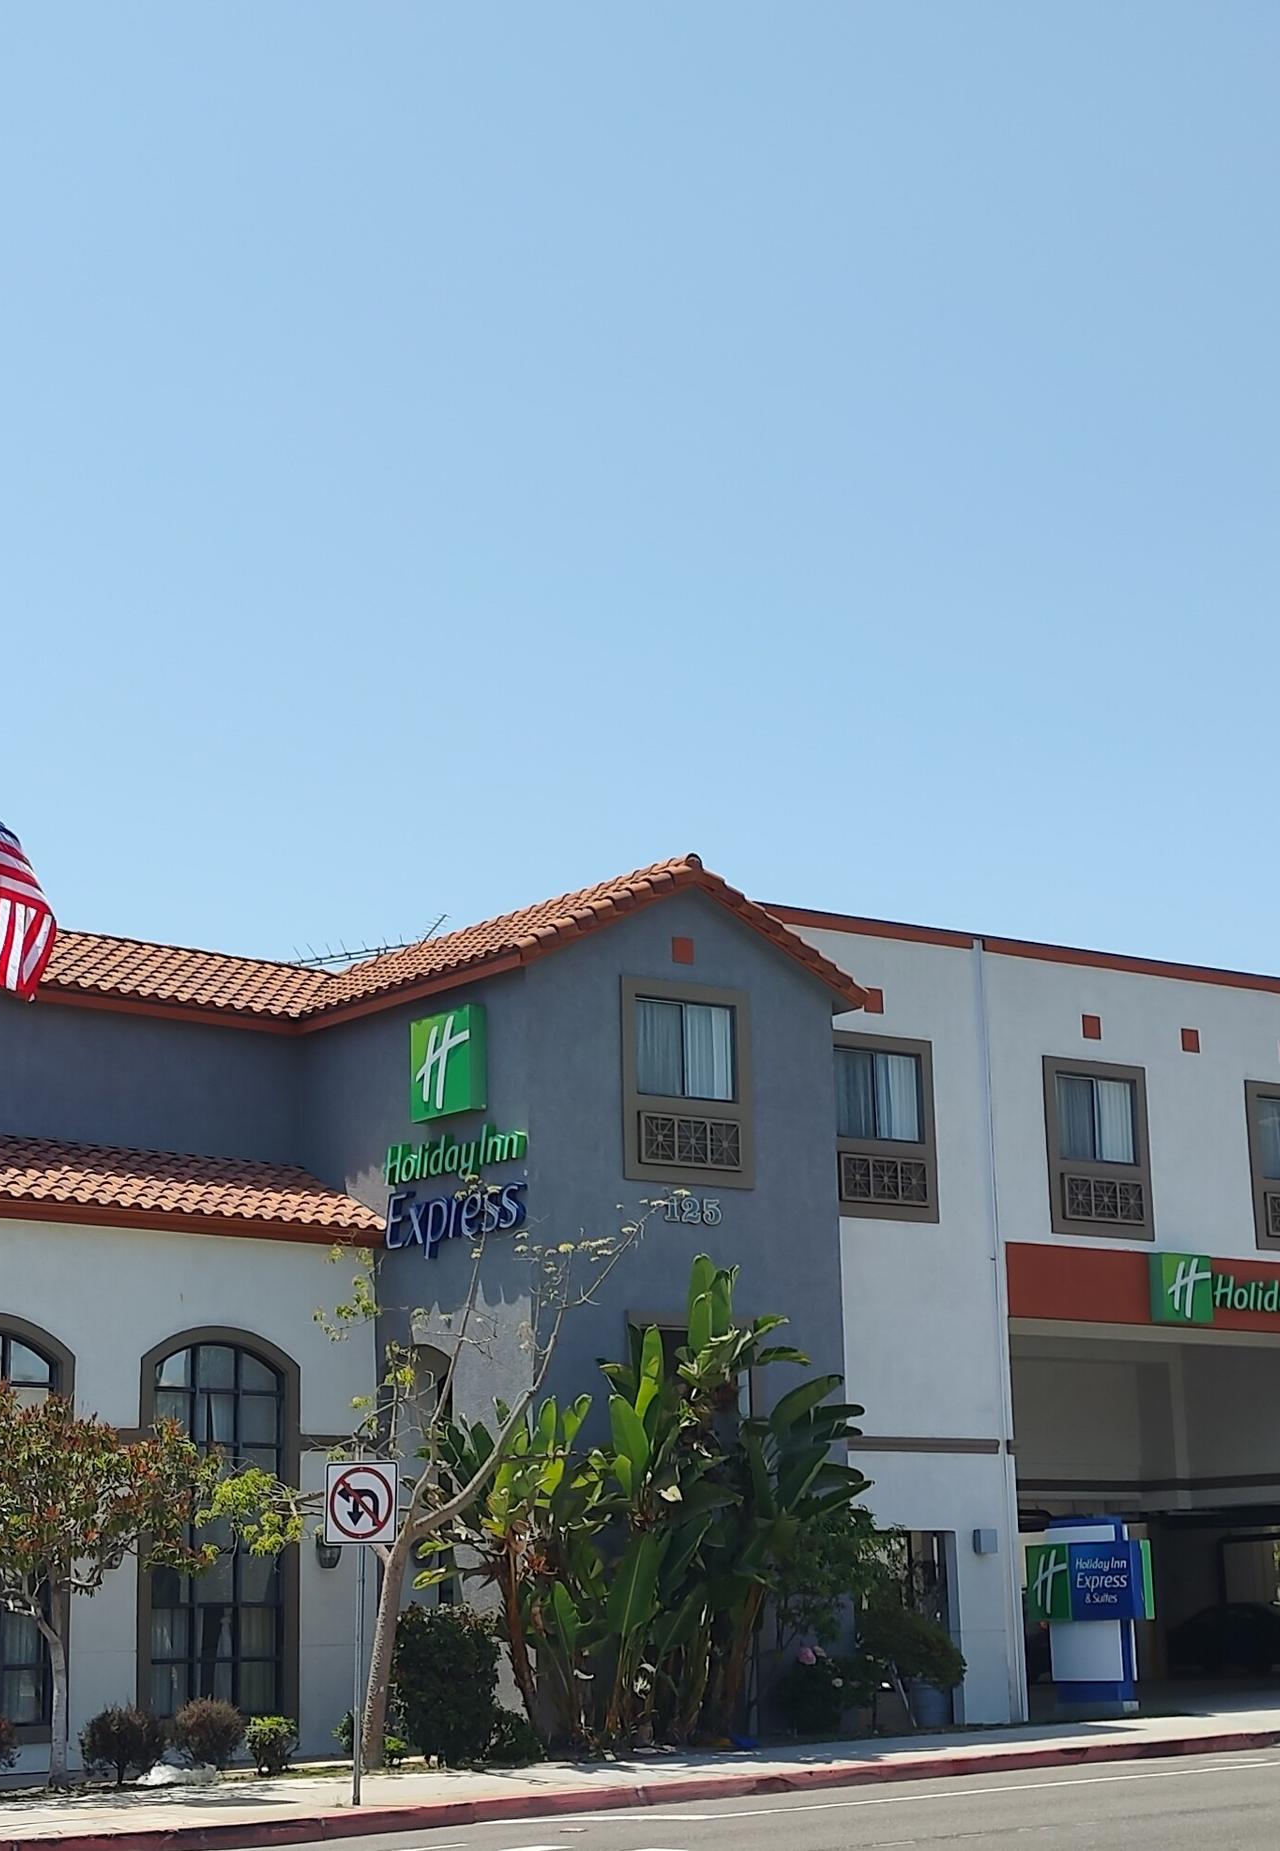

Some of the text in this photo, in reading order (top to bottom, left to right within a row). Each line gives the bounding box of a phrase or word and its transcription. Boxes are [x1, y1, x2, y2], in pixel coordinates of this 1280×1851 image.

[384, 1122, 528, 1187] Holiday Inn
[385, 1182, 528, 1259] Express
[664, 1196, 722, 1226] 125
[1075, 1556, 1127, 1572] Holiday Inn
[1076, 1572, 1128, 1592] Express
[1085, 1592, 1118, 1604] & Suites
